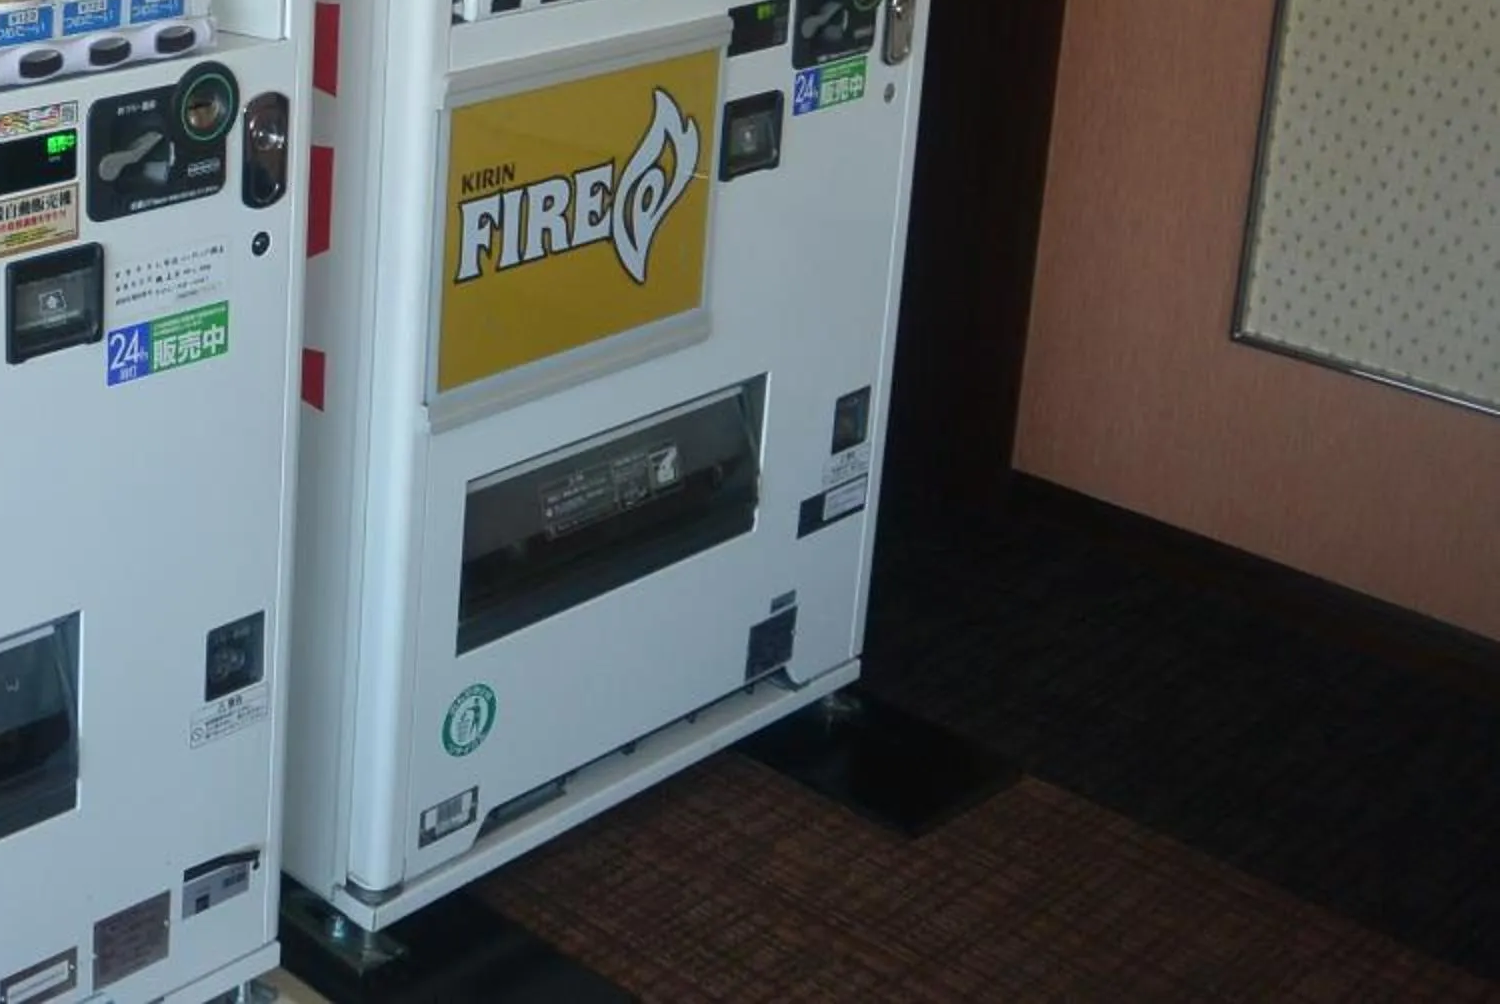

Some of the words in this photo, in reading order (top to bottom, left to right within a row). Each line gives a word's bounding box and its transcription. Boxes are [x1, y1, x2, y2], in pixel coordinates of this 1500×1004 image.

[461, 164, 515, 194] KIRIN
[454, 157, 616, 285] FIRE
[153, 325, 226, 373] 販売中
